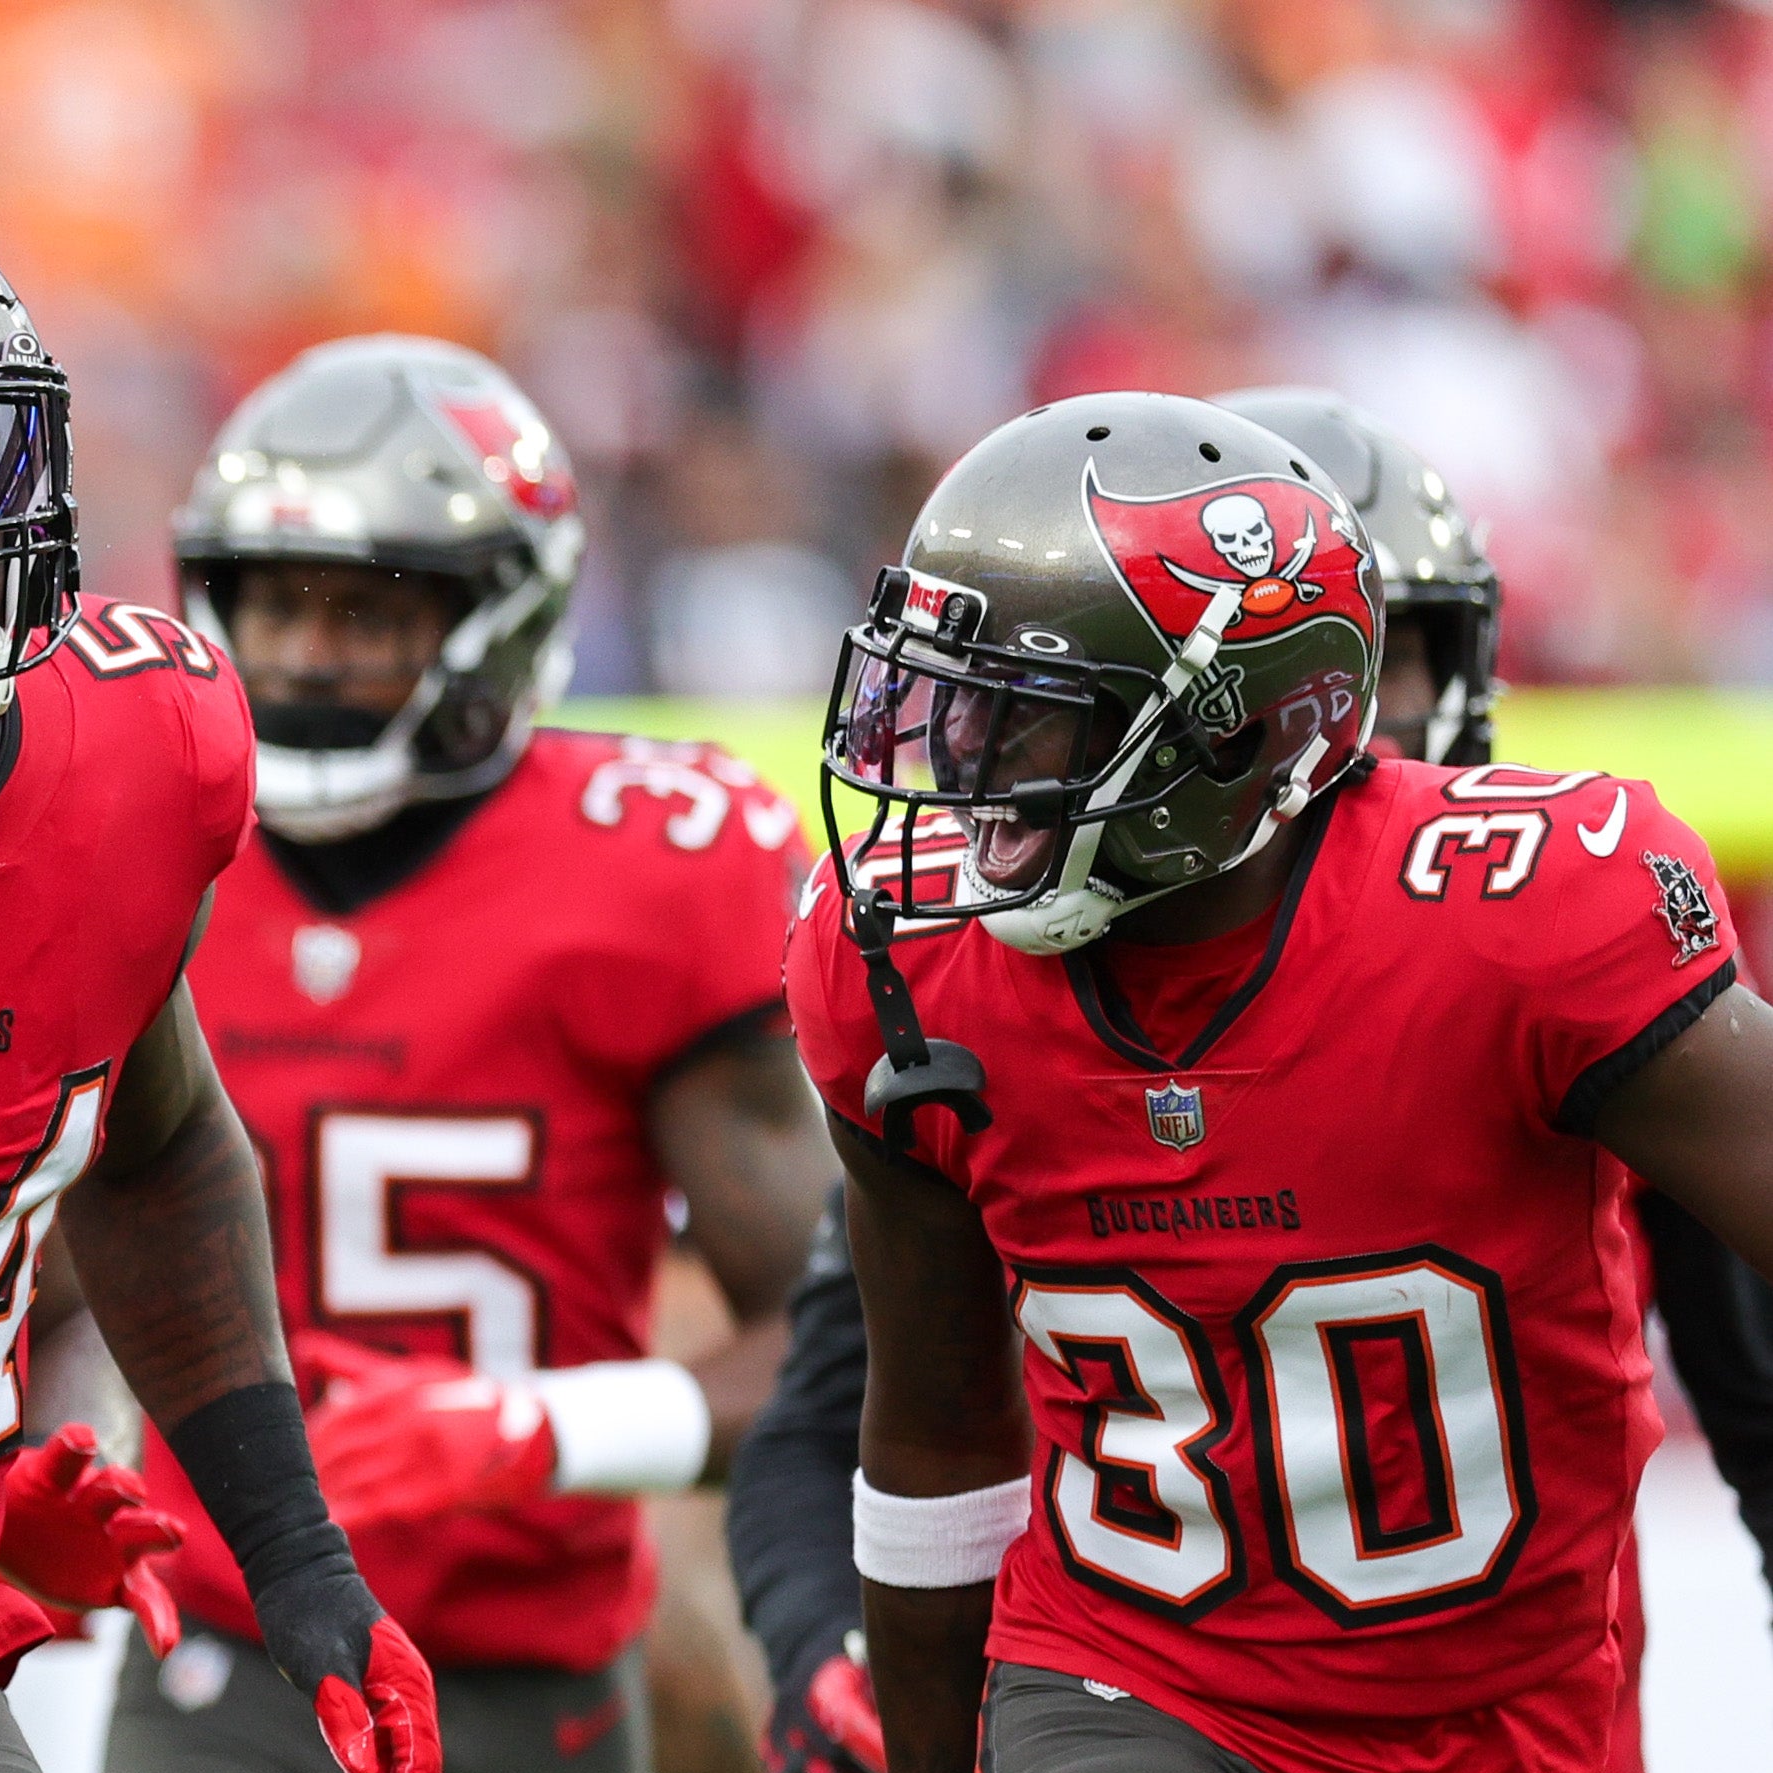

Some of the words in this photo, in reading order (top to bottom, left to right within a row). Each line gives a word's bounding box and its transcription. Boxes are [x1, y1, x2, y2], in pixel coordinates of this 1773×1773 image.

[1398, 762, 1612, 903] 30
[1157, 1114, 1195, 1141] NFL
[1086, 1188, 1302, 1242] BUCCANEERS
[1010, 1246, 1540, 1630] 30
